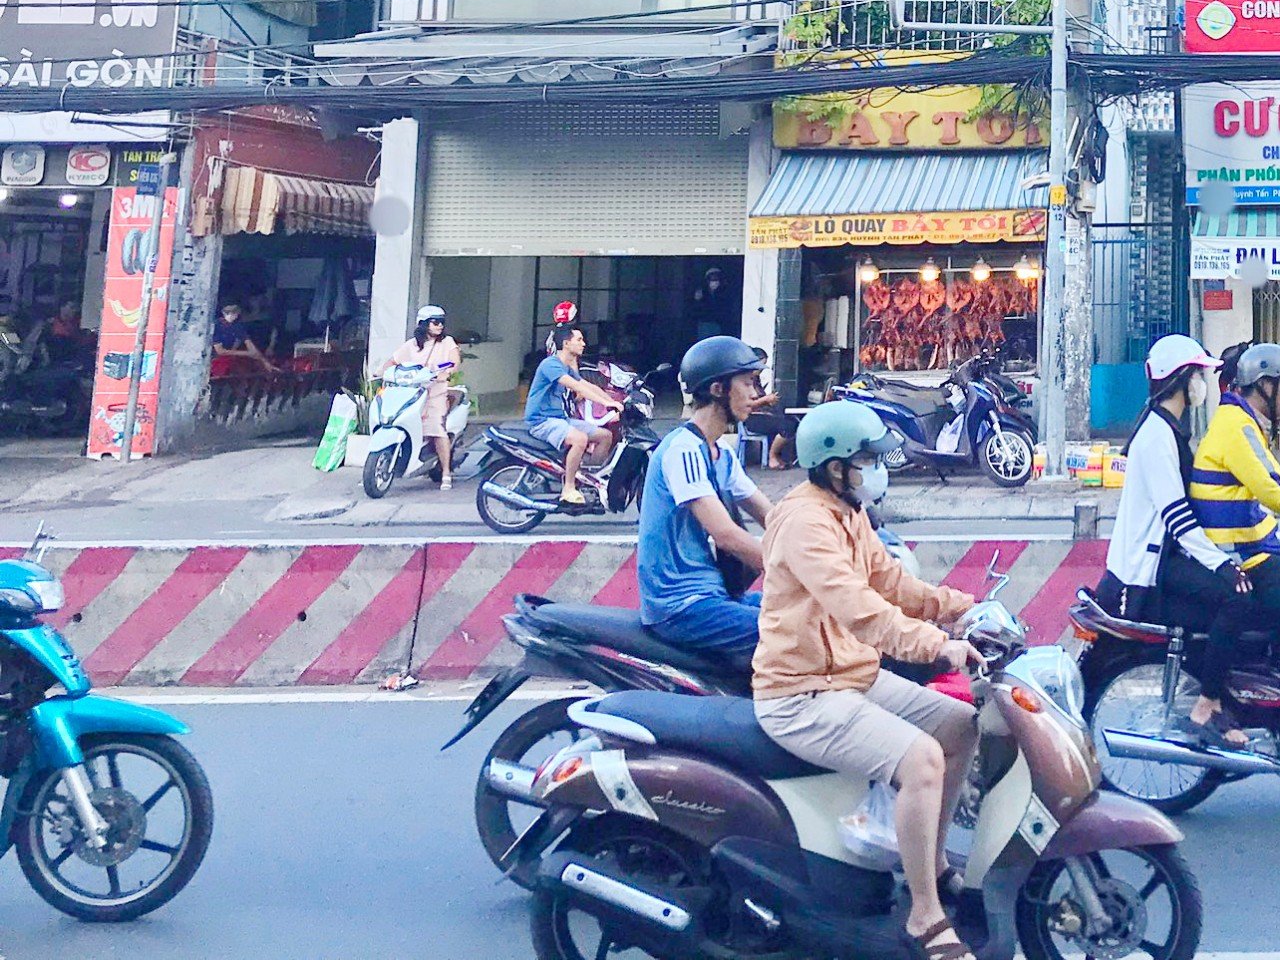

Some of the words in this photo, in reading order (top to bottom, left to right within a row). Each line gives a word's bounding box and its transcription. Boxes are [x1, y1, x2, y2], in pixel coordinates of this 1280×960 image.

[66, 48, 164, 88] GÒN
[1198, 166, 1241, 182] PHÂN
[1245, 164, 1280, 181] PHỐI
[814, 215, 835, 234] LÒ
[841, 218, 887, 235] QUAY
[891, 213, 950, 232] BẢY
